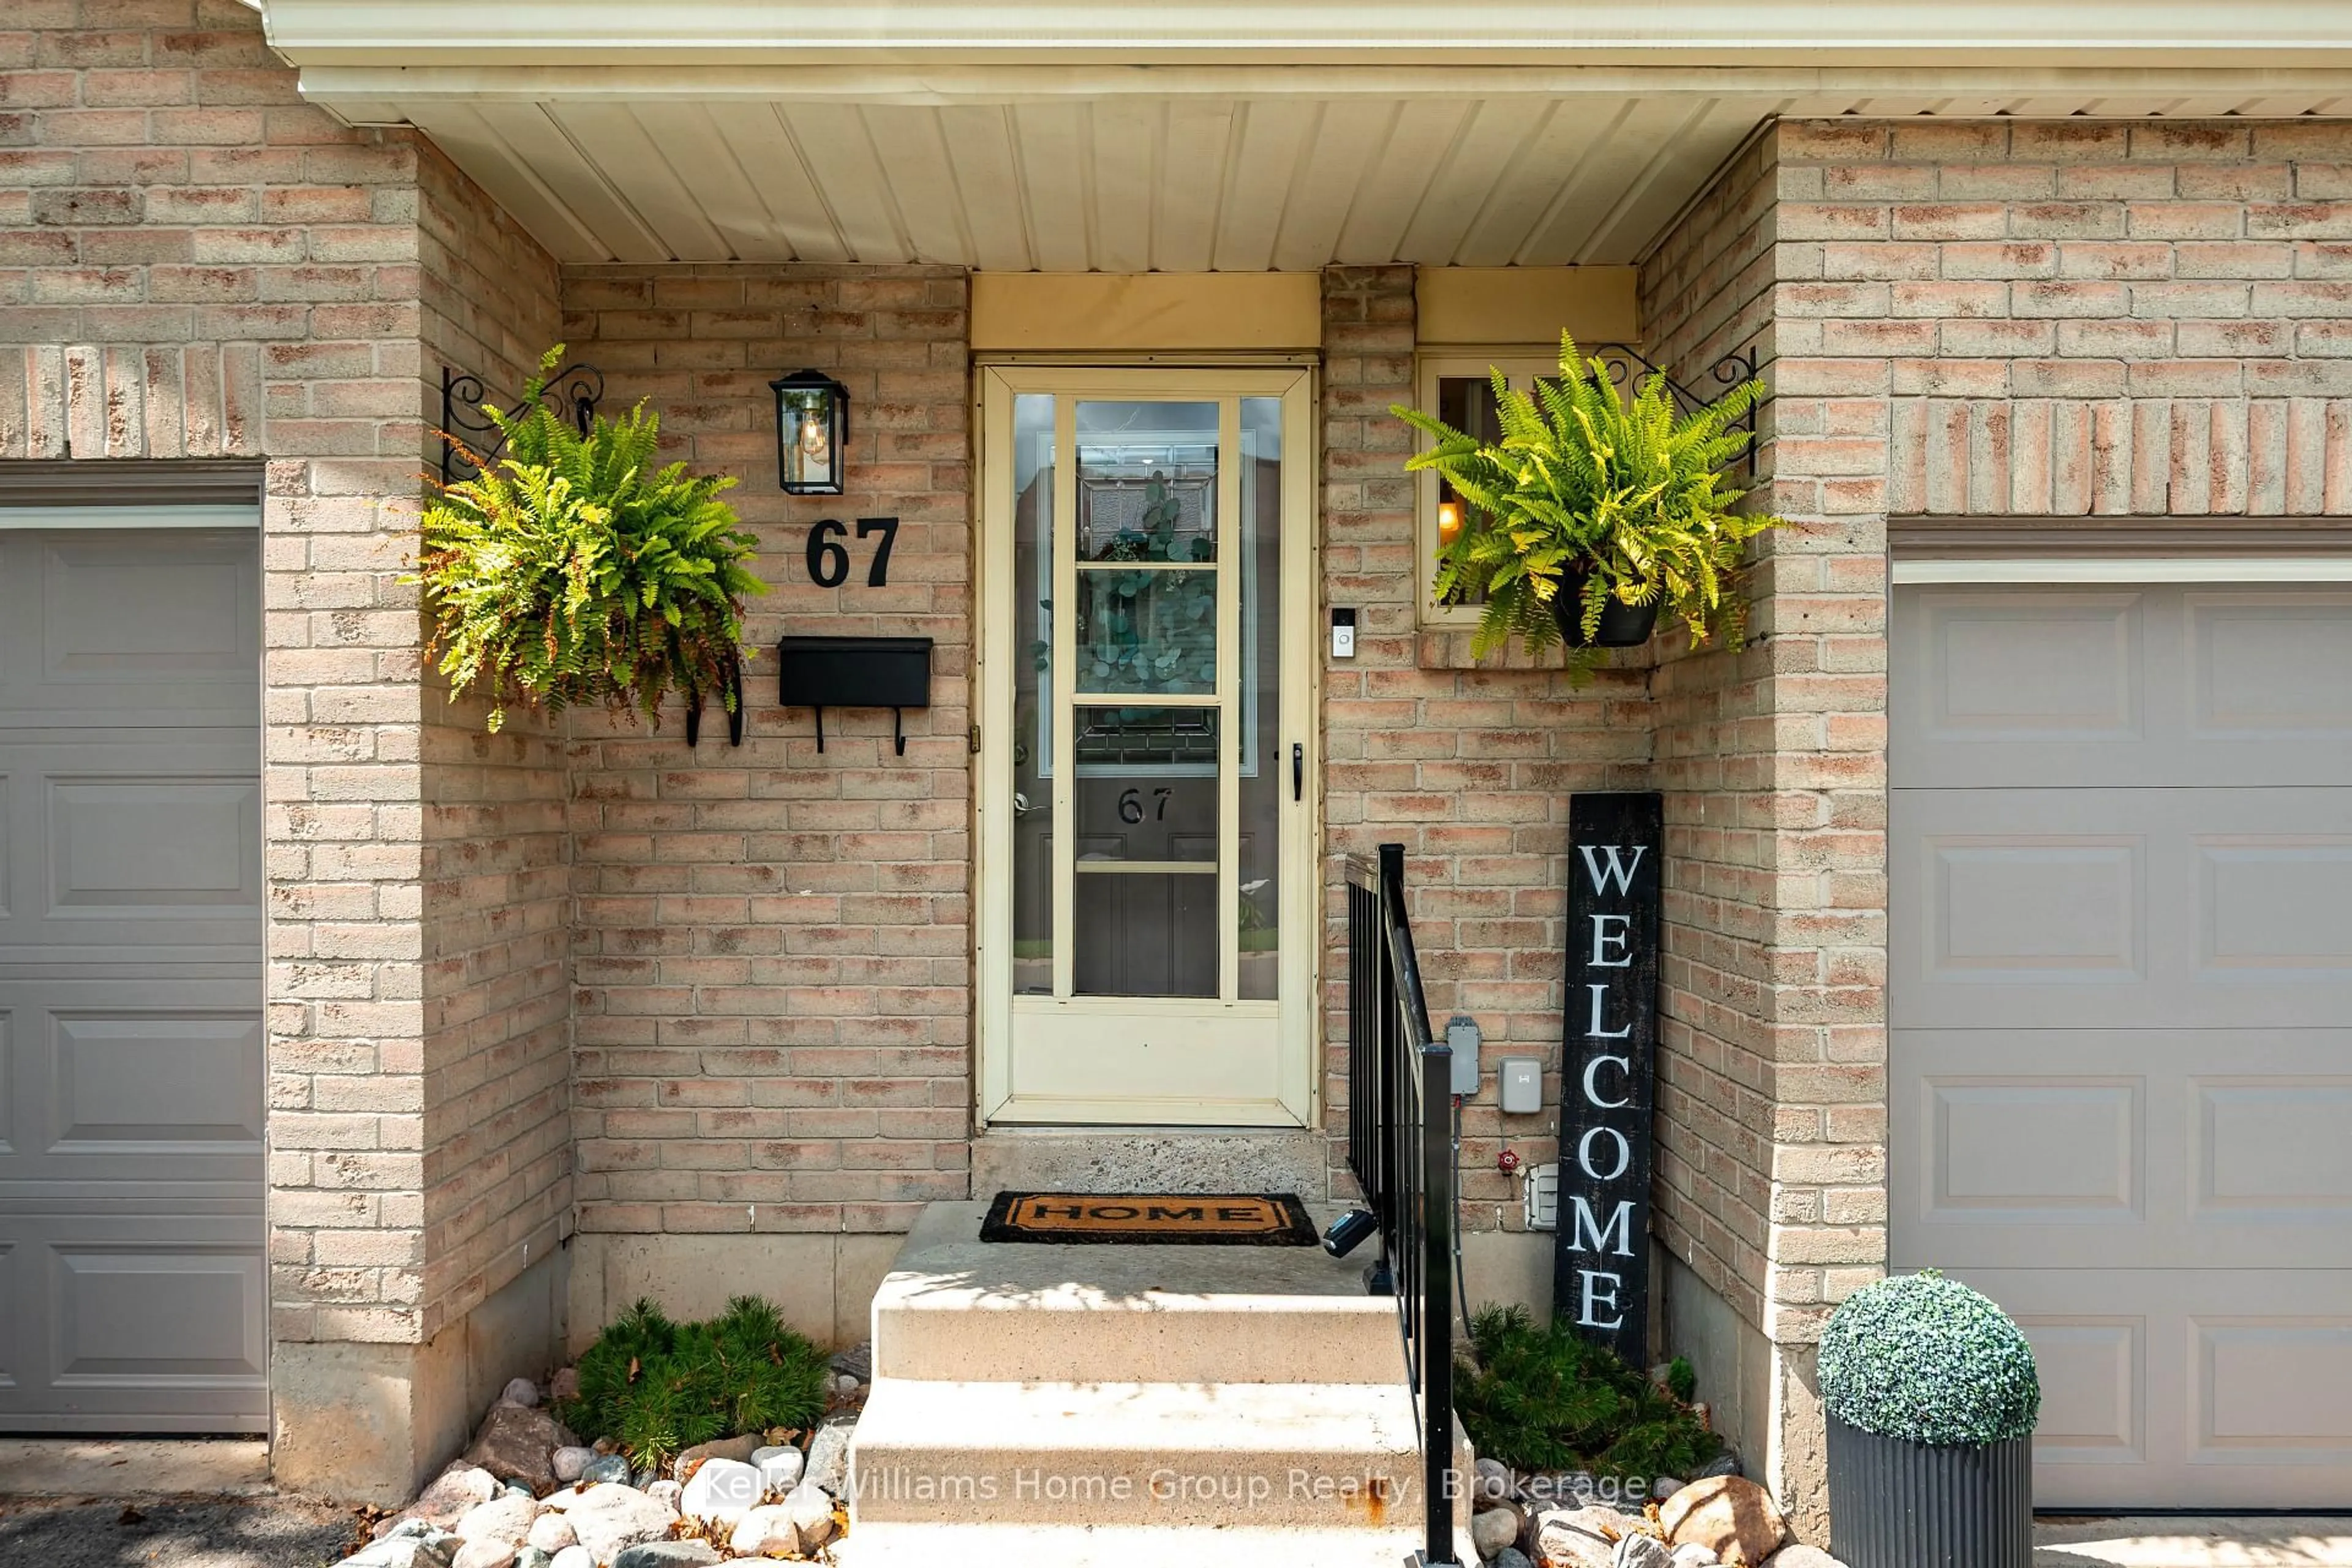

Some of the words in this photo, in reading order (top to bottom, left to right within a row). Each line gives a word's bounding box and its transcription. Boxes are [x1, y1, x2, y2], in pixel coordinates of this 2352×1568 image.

[805, 518, 899, 587] 67
[1118, 788, 1172, 824] 67
[1567, 845, 1647, 1328] WELCOME
[1031, 1205, 1264, 1222] HOME
